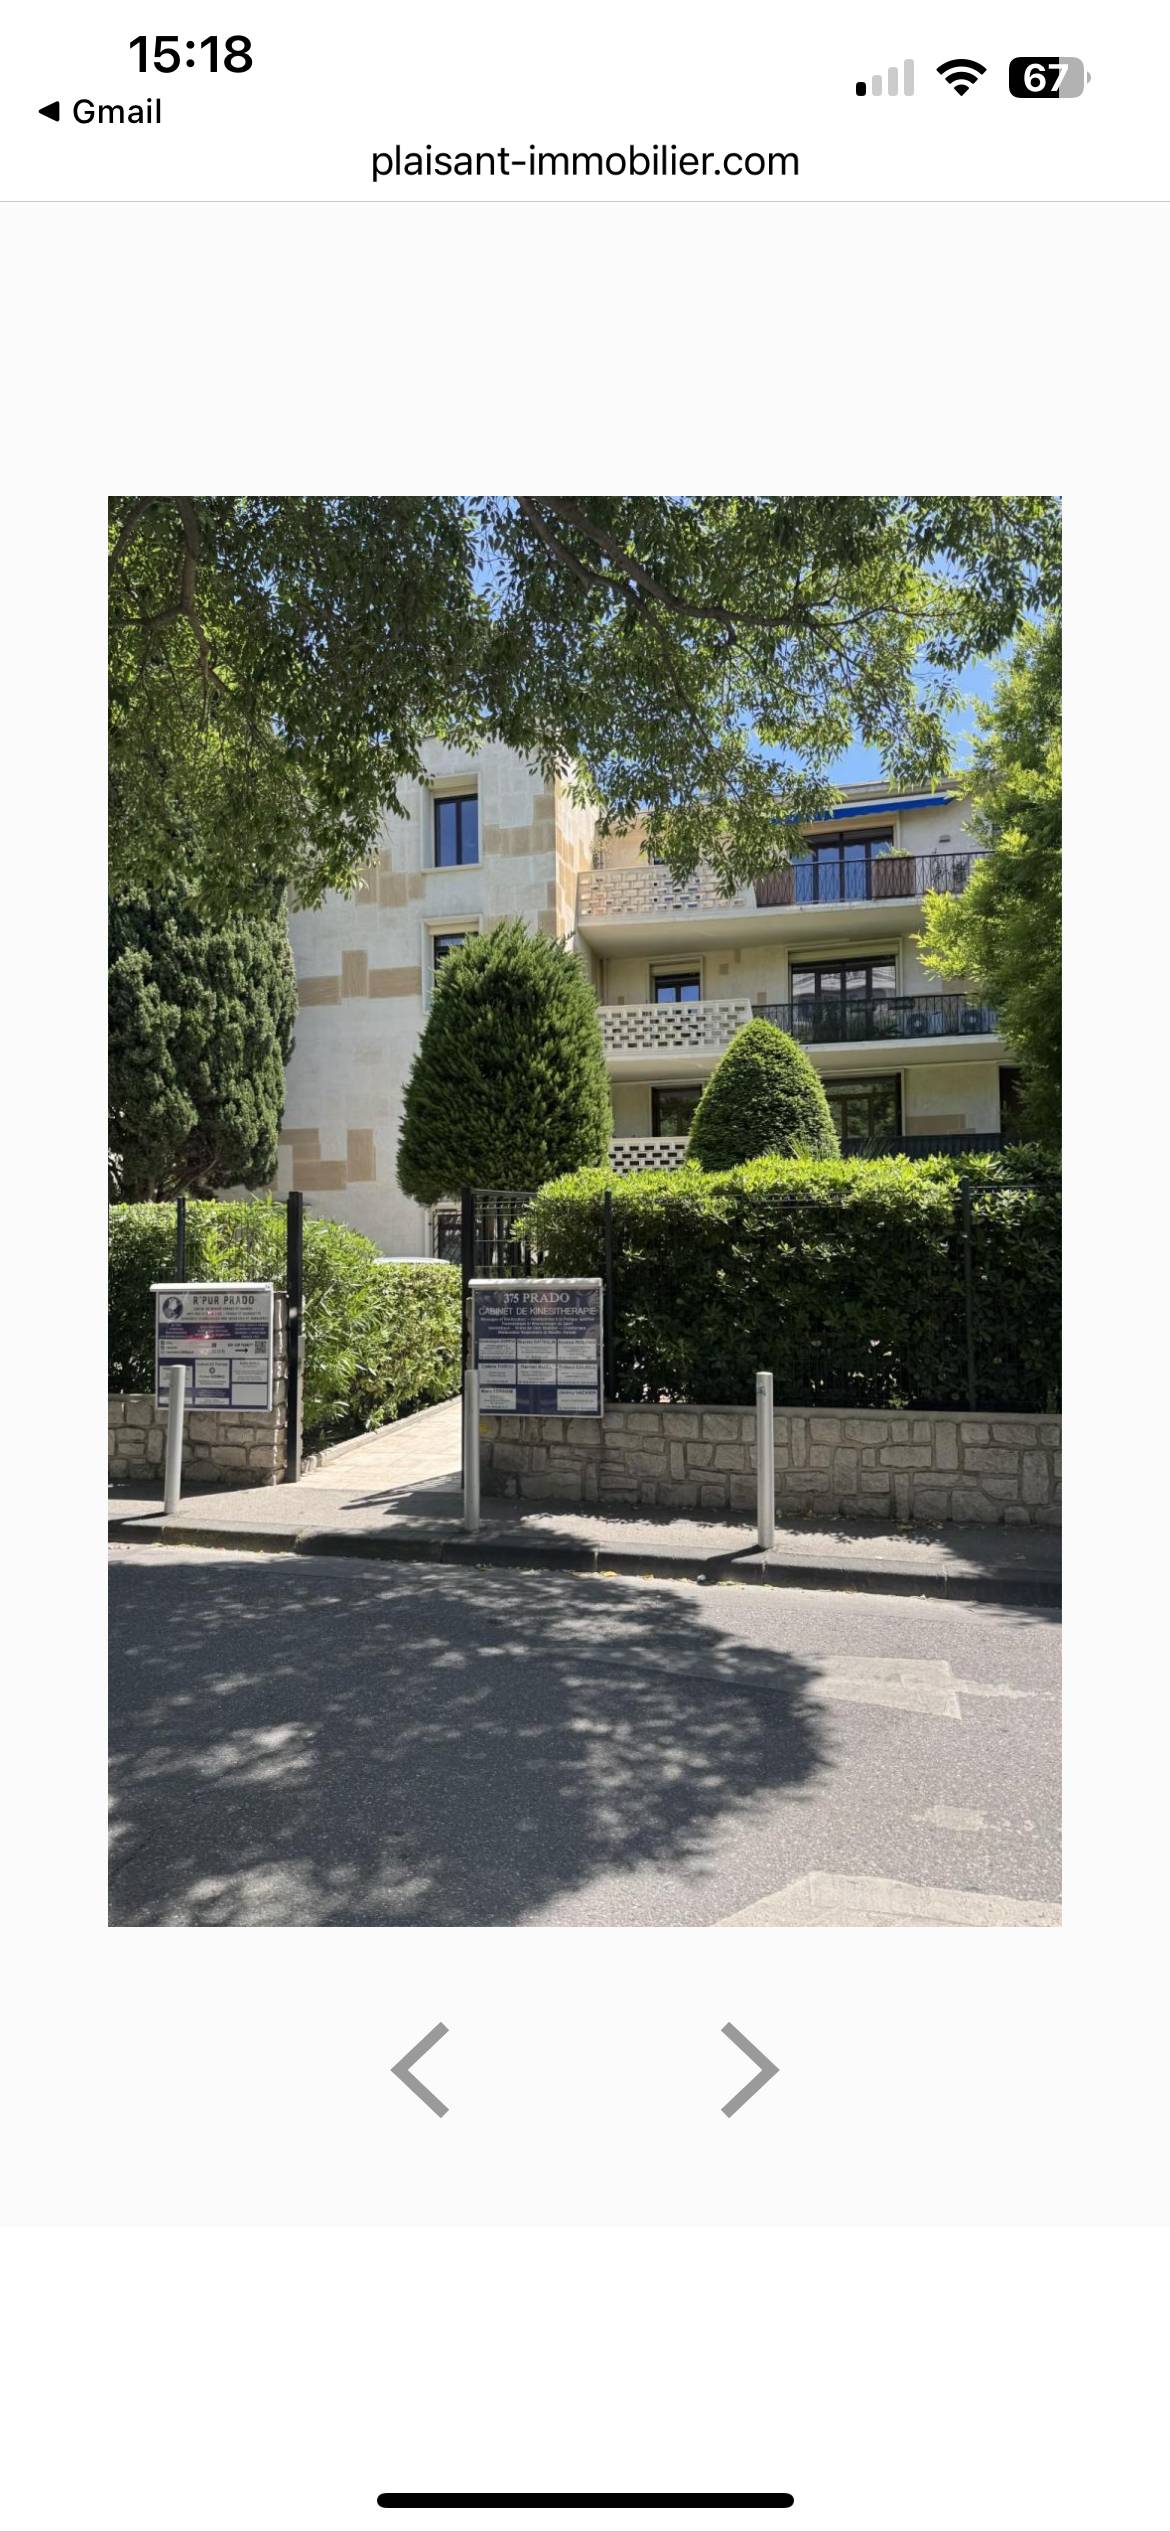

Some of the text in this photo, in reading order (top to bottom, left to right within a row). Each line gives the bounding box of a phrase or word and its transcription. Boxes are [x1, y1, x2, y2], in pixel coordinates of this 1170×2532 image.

[129, 35, 253, 74] 15:18
[1023, 62, 1069, 93] 67
[72, 97, 162, 125] Gmail
[371, 144, 800, 183] plaisant-immobilier.com
[223, 1296, 255, 1305] PRADO
[478, 1307, 512, 1316] CABINET
[516, 1307, 528, 1316] DE
[503, 1292, 570, 1303] 375 PRADO
